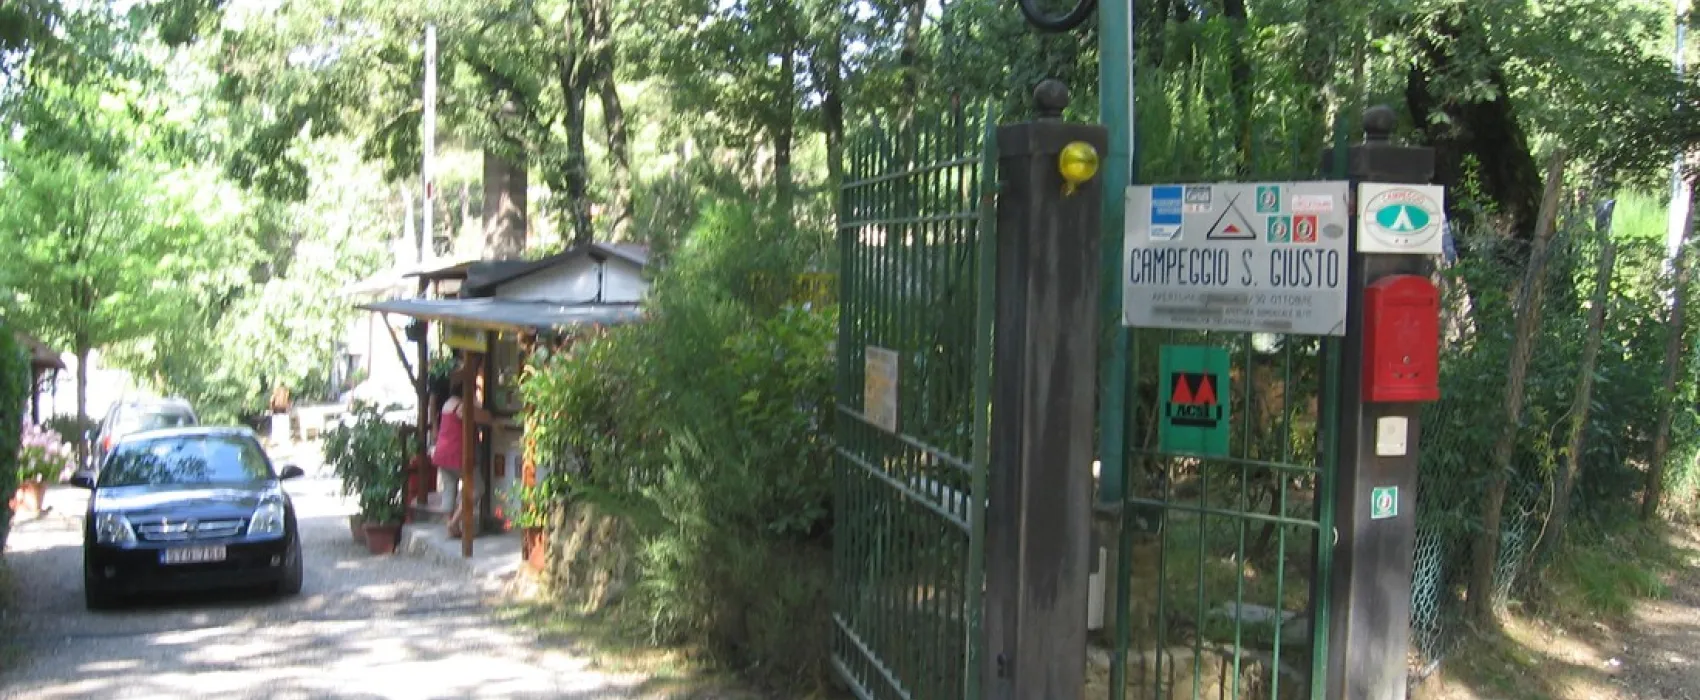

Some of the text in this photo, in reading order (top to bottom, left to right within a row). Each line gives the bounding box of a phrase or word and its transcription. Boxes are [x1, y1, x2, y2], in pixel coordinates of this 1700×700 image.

[1130, 248, 1339, 289] CAMPEGGIO S. GIUSTO
